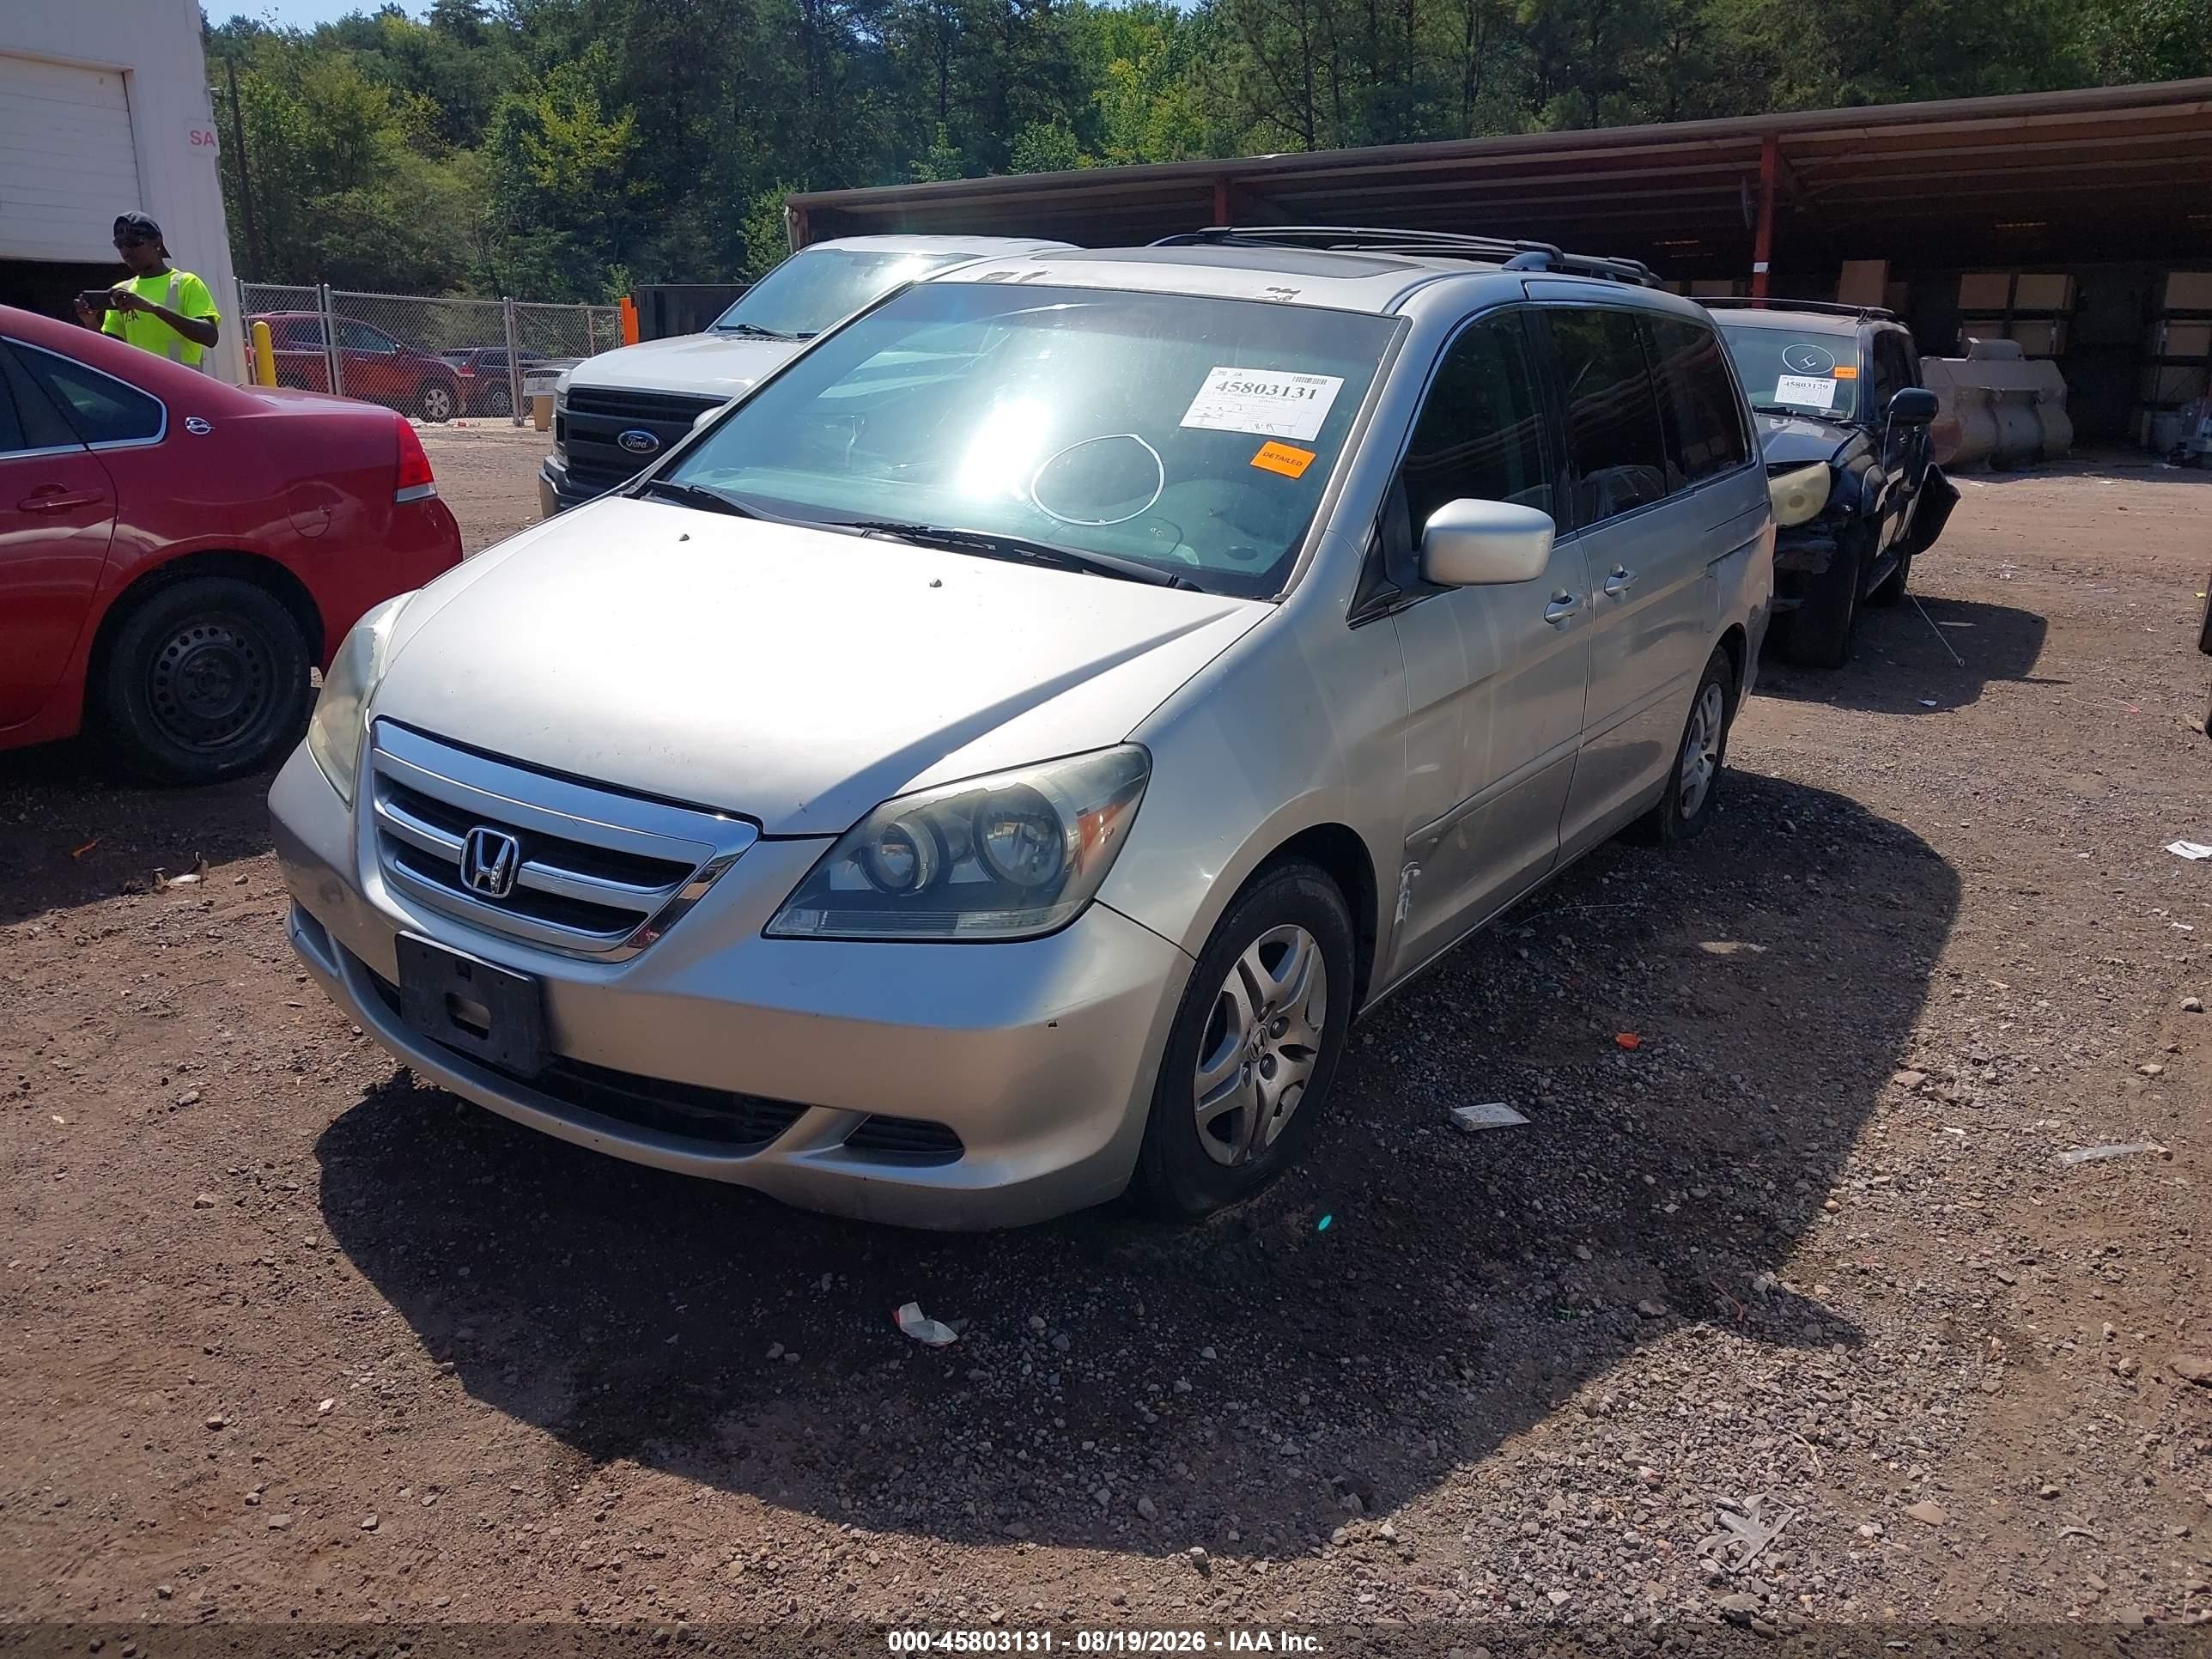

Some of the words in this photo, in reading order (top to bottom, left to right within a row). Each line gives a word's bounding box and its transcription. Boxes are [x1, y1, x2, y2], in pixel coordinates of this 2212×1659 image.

[1215, 380, 1319, 400] 45803131
[625, 434, 649, 448] Ford
[1262, 451, 1304, 467] DETAILED
